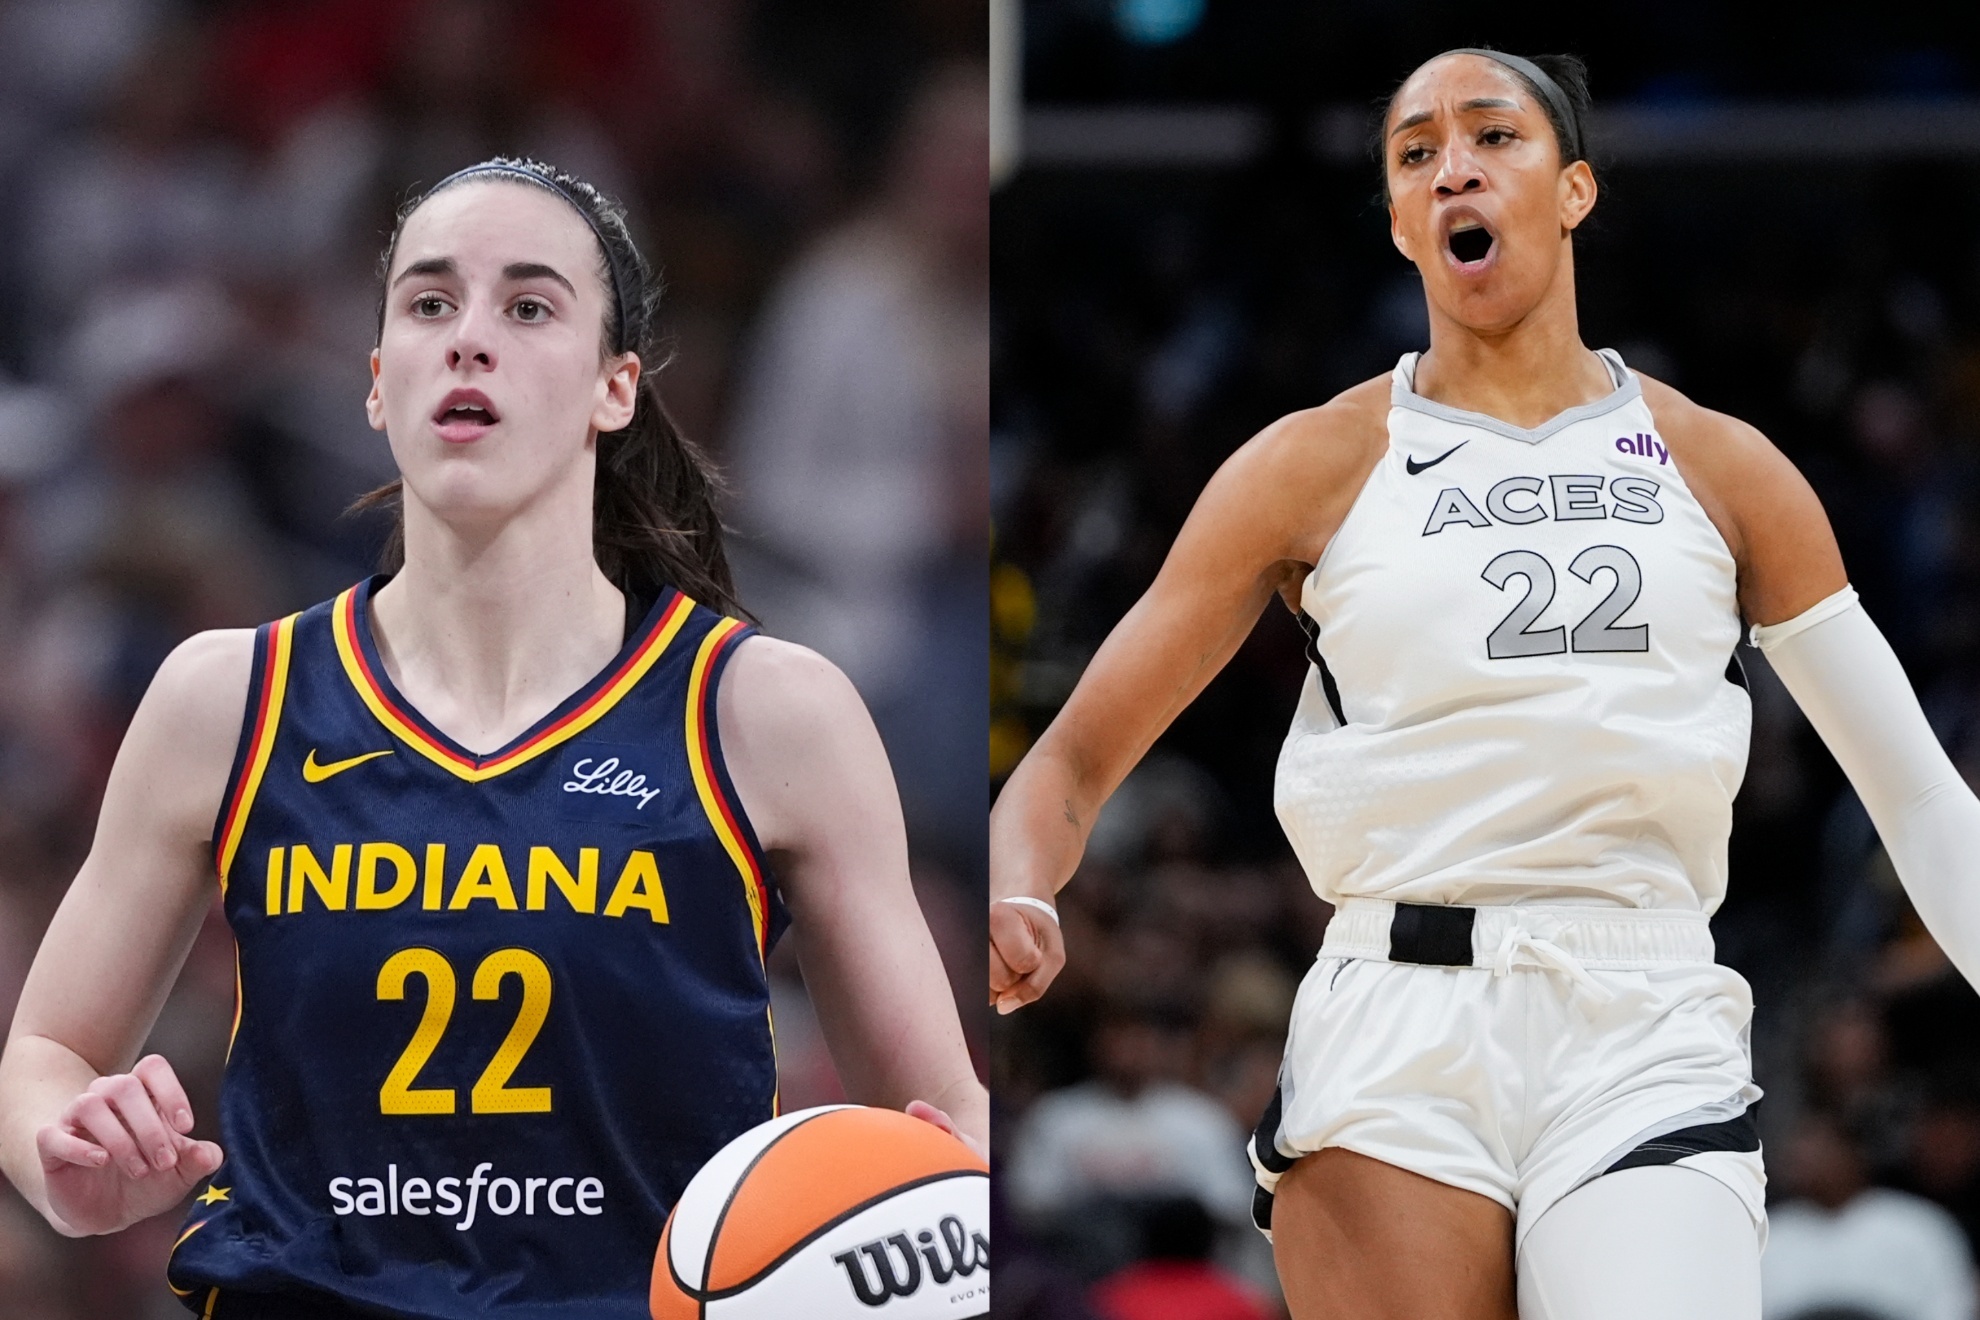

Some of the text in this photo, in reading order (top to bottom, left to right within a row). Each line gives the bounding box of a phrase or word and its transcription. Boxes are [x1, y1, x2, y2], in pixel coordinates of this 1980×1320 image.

[1615, 433, 1669, 466] ally
[1421, 474, 1664, 537] ACES
[1480, 544, 1649, 659] 22
[563, 757, 660, 810] Lilly
[266, 842, 670, 925] INDIANA
[376, 946, 553, 1115] 22
[328, 1163, 605, 1231] salesforce
[950, 1290, 974, 1304] EVO
